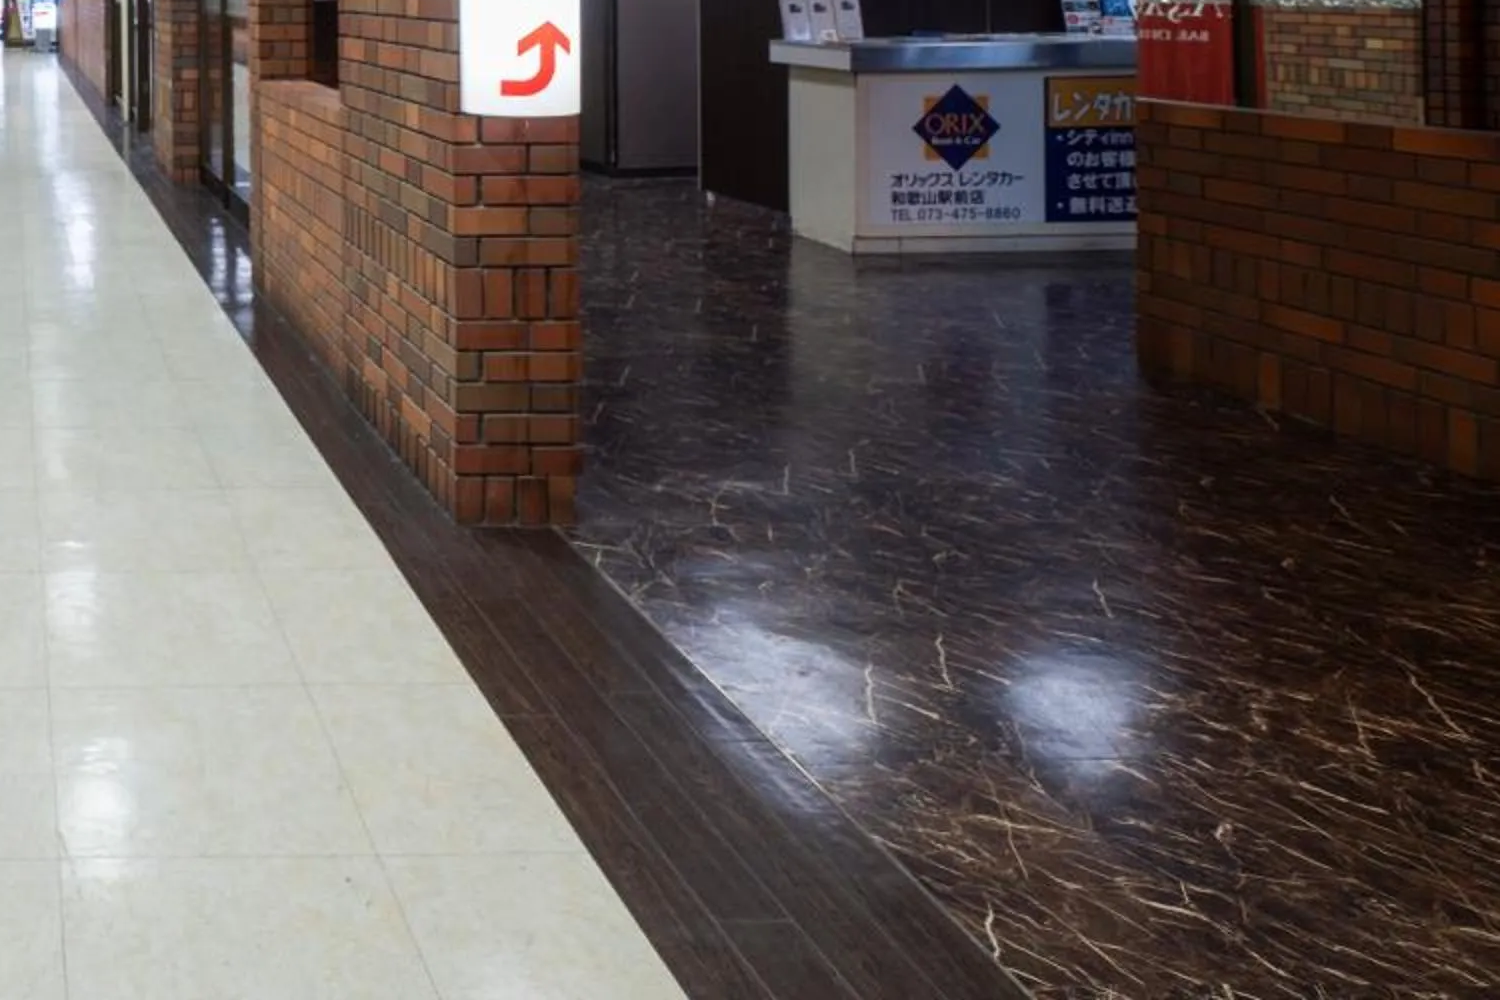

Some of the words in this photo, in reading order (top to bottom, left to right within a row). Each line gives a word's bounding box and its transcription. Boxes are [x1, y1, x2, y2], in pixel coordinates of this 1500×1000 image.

[924, 113, 985, 135] ORIX
[891, 172, 954, 188] オリックス
[959, 171, 1025, 188] レンタカー
